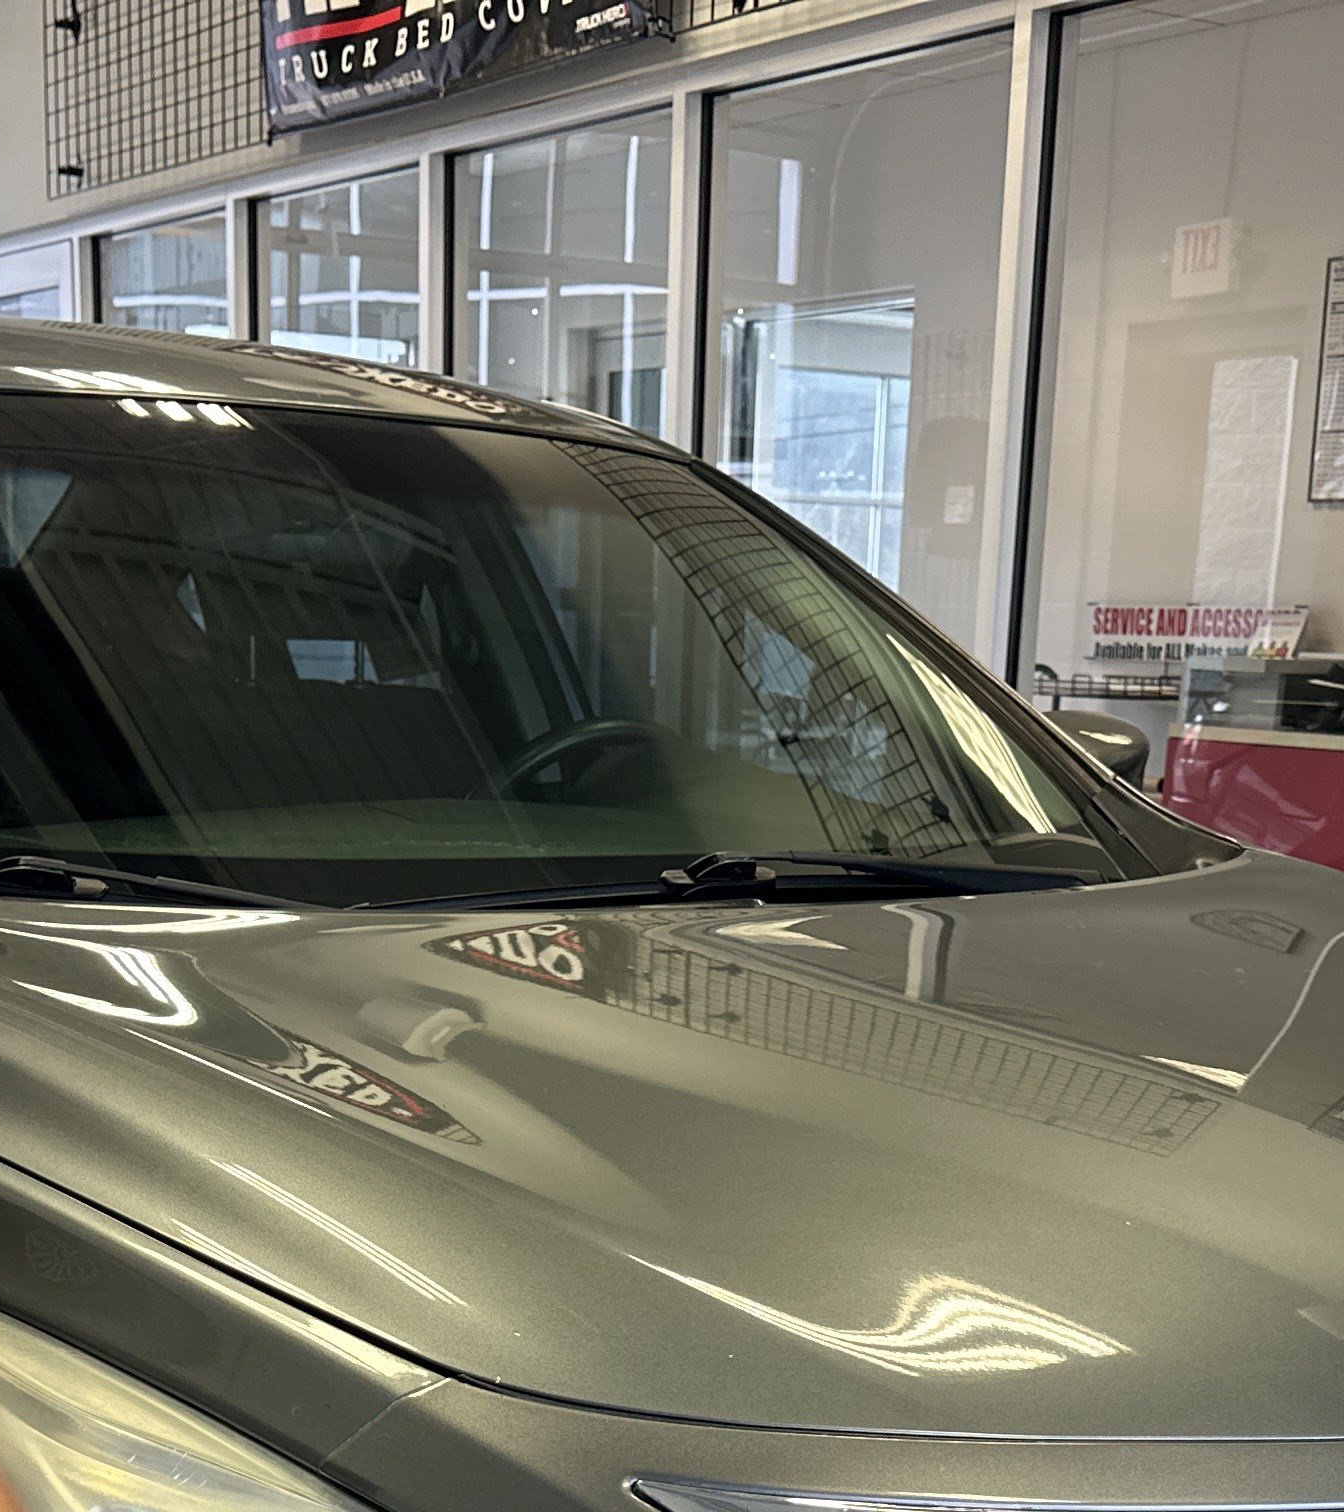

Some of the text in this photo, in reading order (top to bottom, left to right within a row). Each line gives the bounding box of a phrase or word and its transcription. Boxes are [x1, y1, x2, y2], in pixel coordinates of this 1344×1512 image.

[277, 37, 380, 86] TRUCK
[394, 11, 456, 58] BED
[1092, 605, 1153, 636] SERVICE
[1155, 606, 1188, 637] AND
